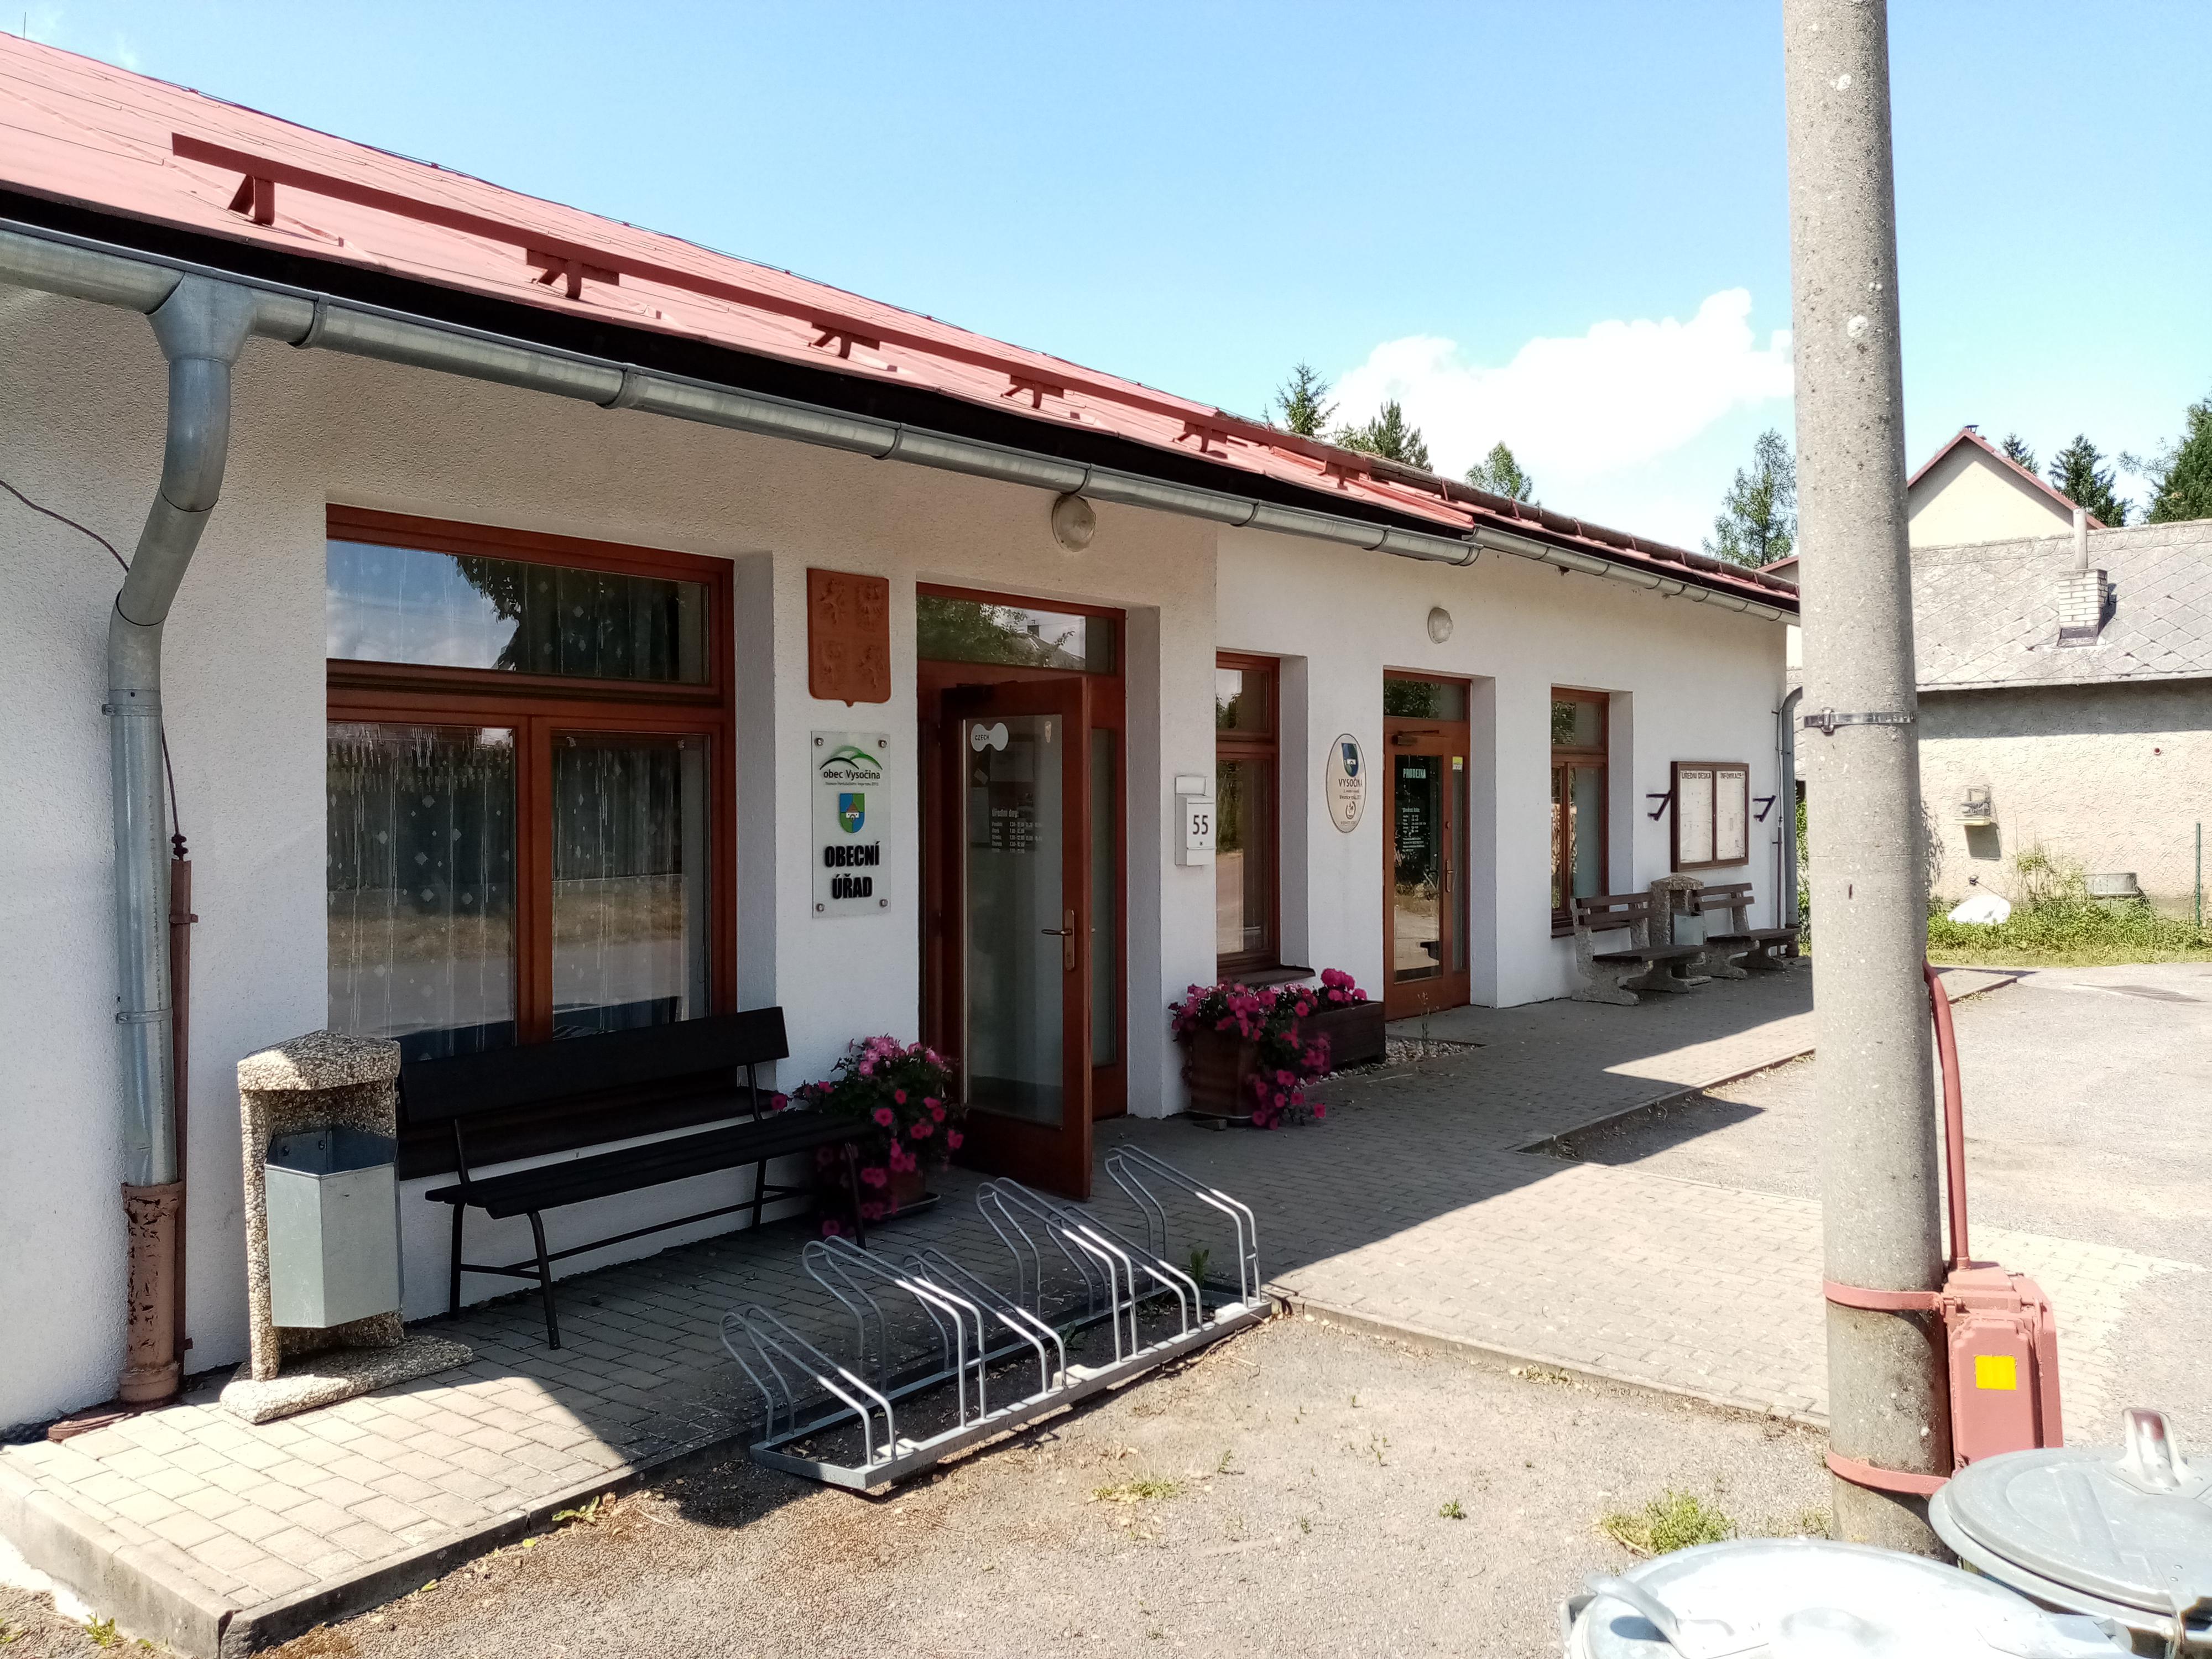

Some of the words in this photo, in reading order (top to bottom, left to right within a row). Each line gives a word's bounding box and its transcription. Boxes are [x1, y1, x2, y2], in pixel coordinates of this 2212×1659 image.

[823, 769, 843, 779] obec
[846, 769, 880, 781] Vysočina
[1192, 815, 1209, 834] 55
[825, 841, 881, 868] OBECNÍ
[832, 873, 873, 900] ÚŘAD
